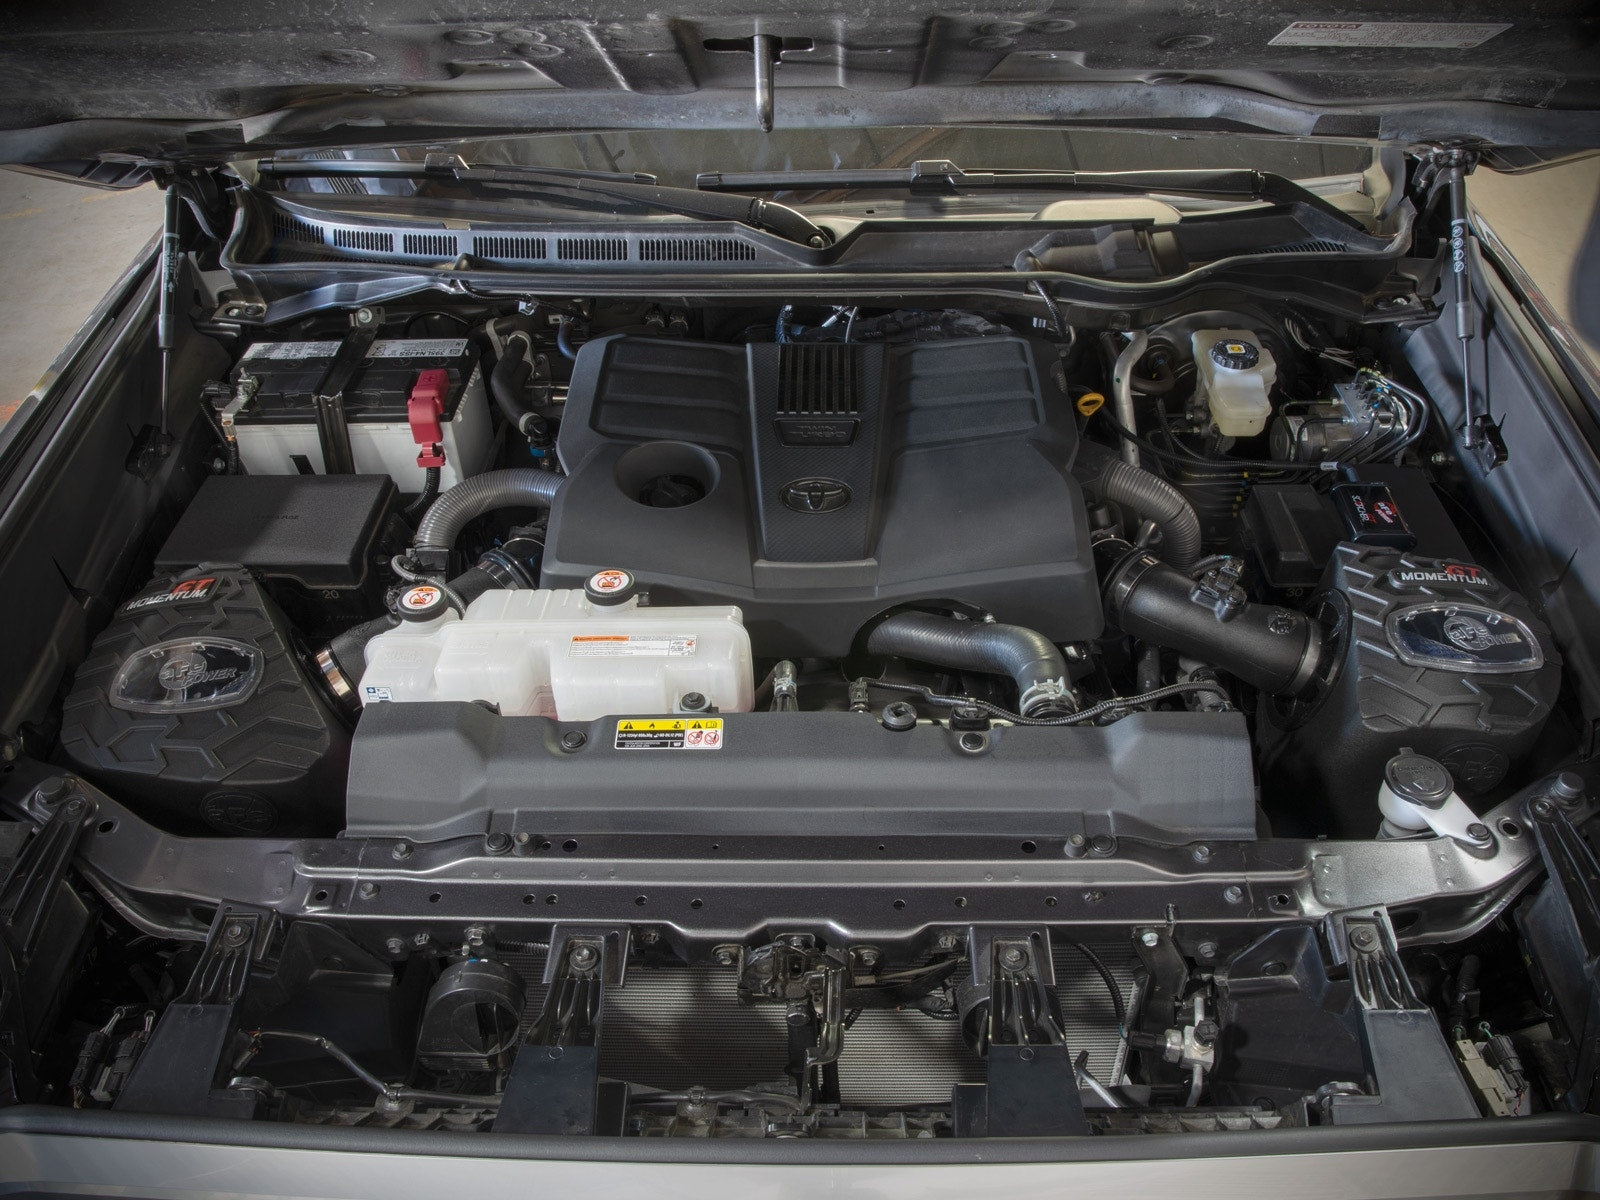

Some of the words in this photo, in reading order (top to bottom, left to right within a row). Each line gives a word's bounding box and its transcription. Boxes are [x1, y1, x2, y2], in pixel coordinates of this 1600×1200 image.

[1446, 564, 1481, 577] GT
[171, 578, 216, 594] GT
[1401, 572, 1489, 586] MOMENTUM
[126, 588, 208, 611] MOMENTUM
[322, 589, 340, 600] 20
[1286, 587, 1304, 598] 30
[181, 667, 238, 688] POWER
